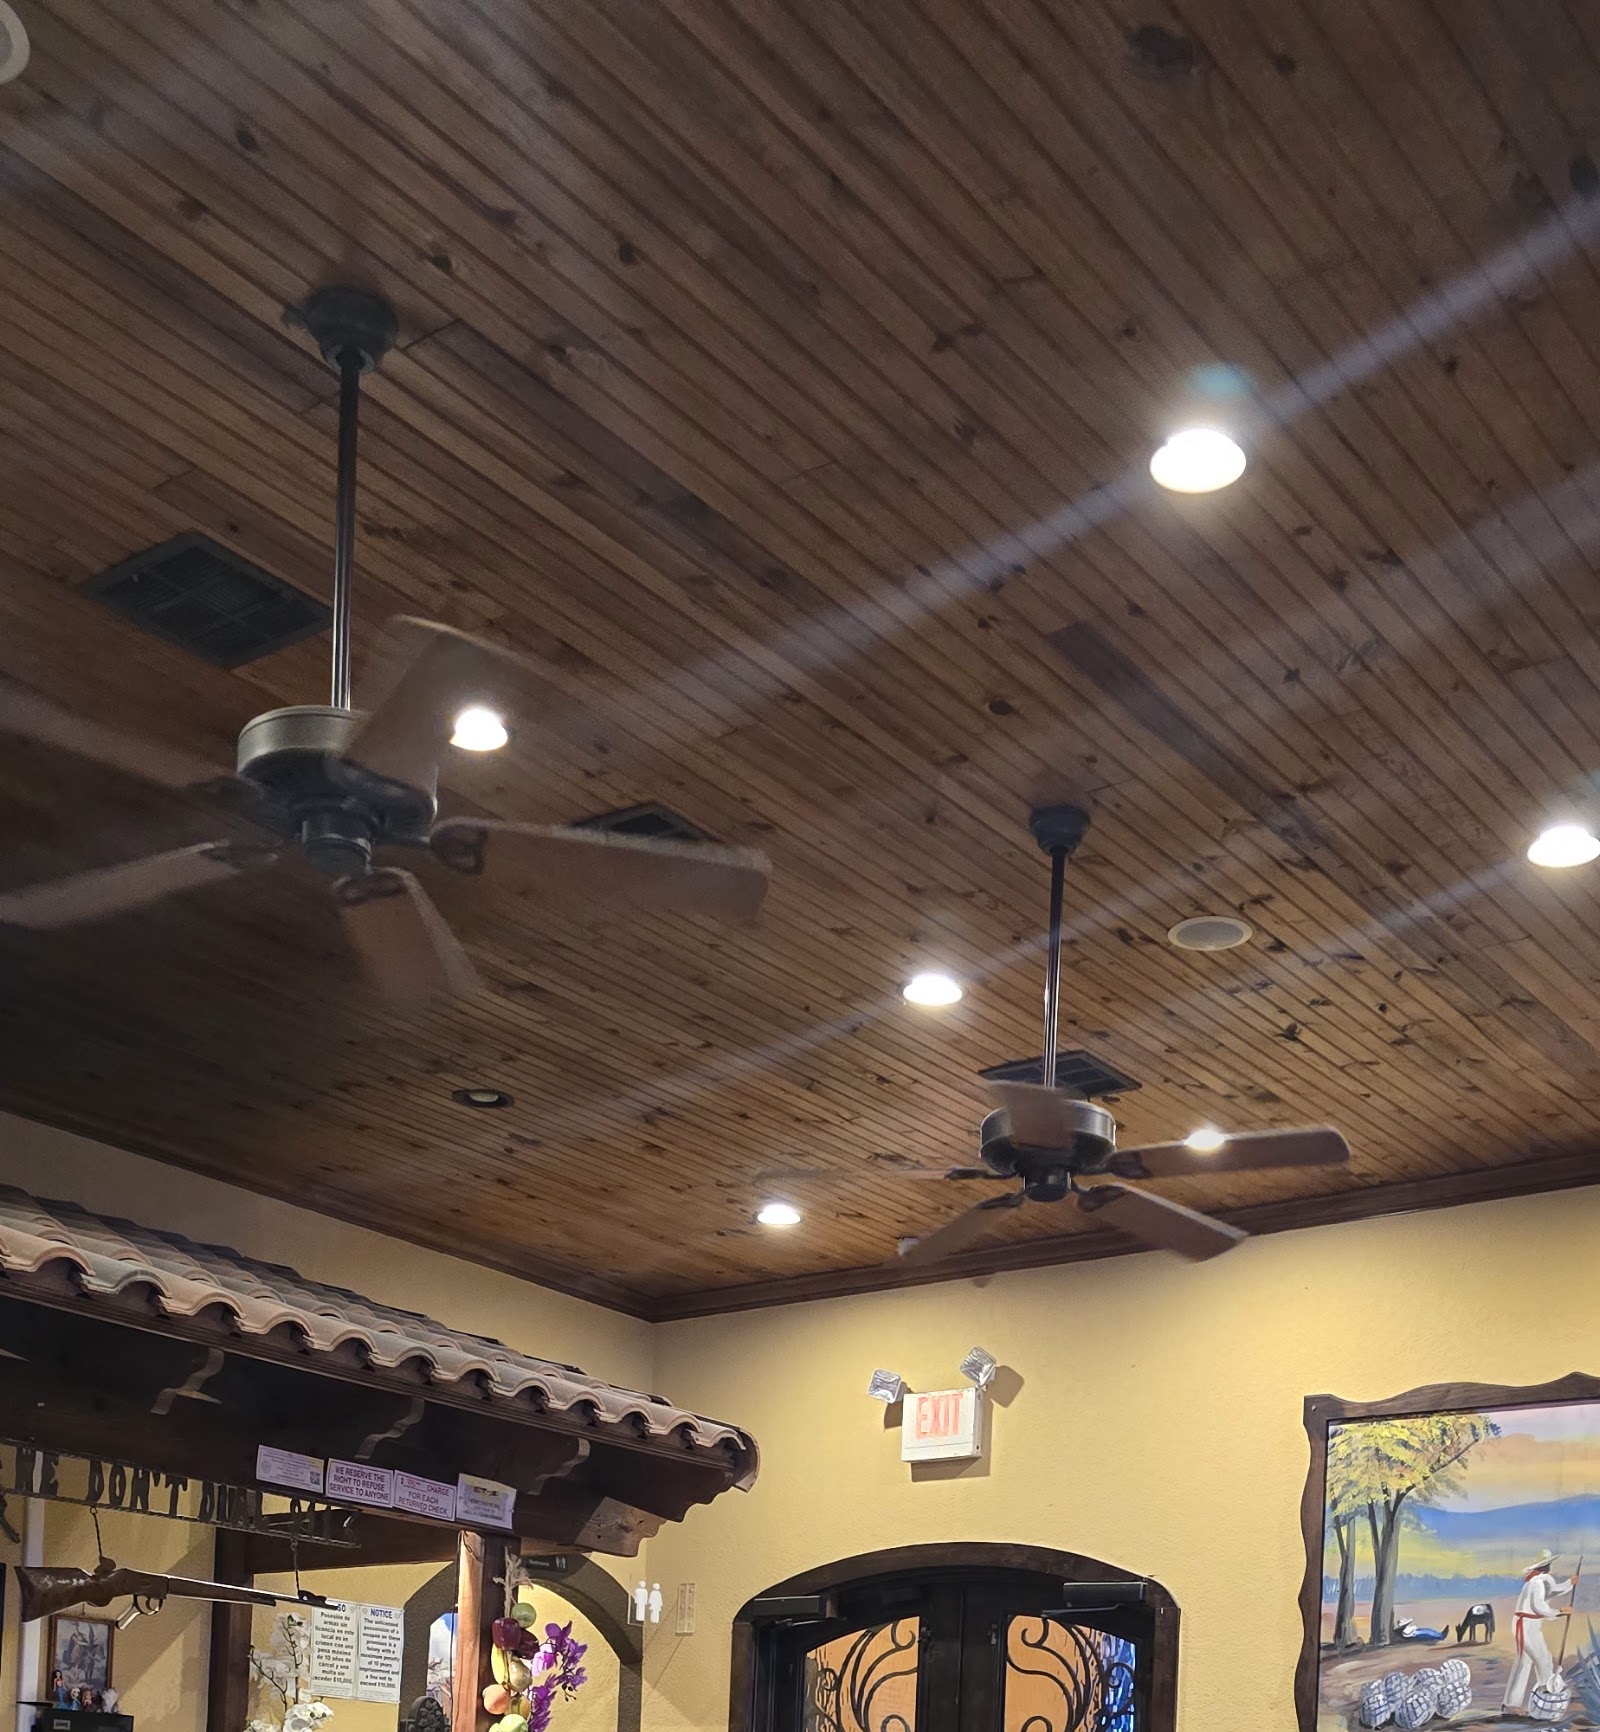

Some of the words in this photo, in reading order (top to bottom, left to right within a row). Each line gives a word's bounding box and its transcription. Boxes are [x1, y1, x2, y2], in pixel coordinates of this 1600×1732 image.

[916, 1392, 964, 1439] EXIT
[335, 1466, 344, 1475] WE
[345, 1467, 372, 1479] RESERVE
[374, 1473, 385, 1483] THE
[86, 1458, 188, 1518] DON'T
[329, 1483, 354, 1494] SERVICE
[356, 1488, 364, 1496] TO
[365, 1489, 389, 1500] ANYONE
[334, 1475, 352, 1485] RIGHT
[353, 1478, 361, 1487] TO
[362, 1479, 385, 1492] REFUSE
[426, 1485, 449, 1496] CHARGE
[399, 1497, 427, 1510] RETURNED
[428, 1504, 448, 1515] CHECK
[409, 1491, 420, 1499] FOR
[422, 1494, 439, 1504] EACH
[370, 1608, 392, 1619] NOTICE
